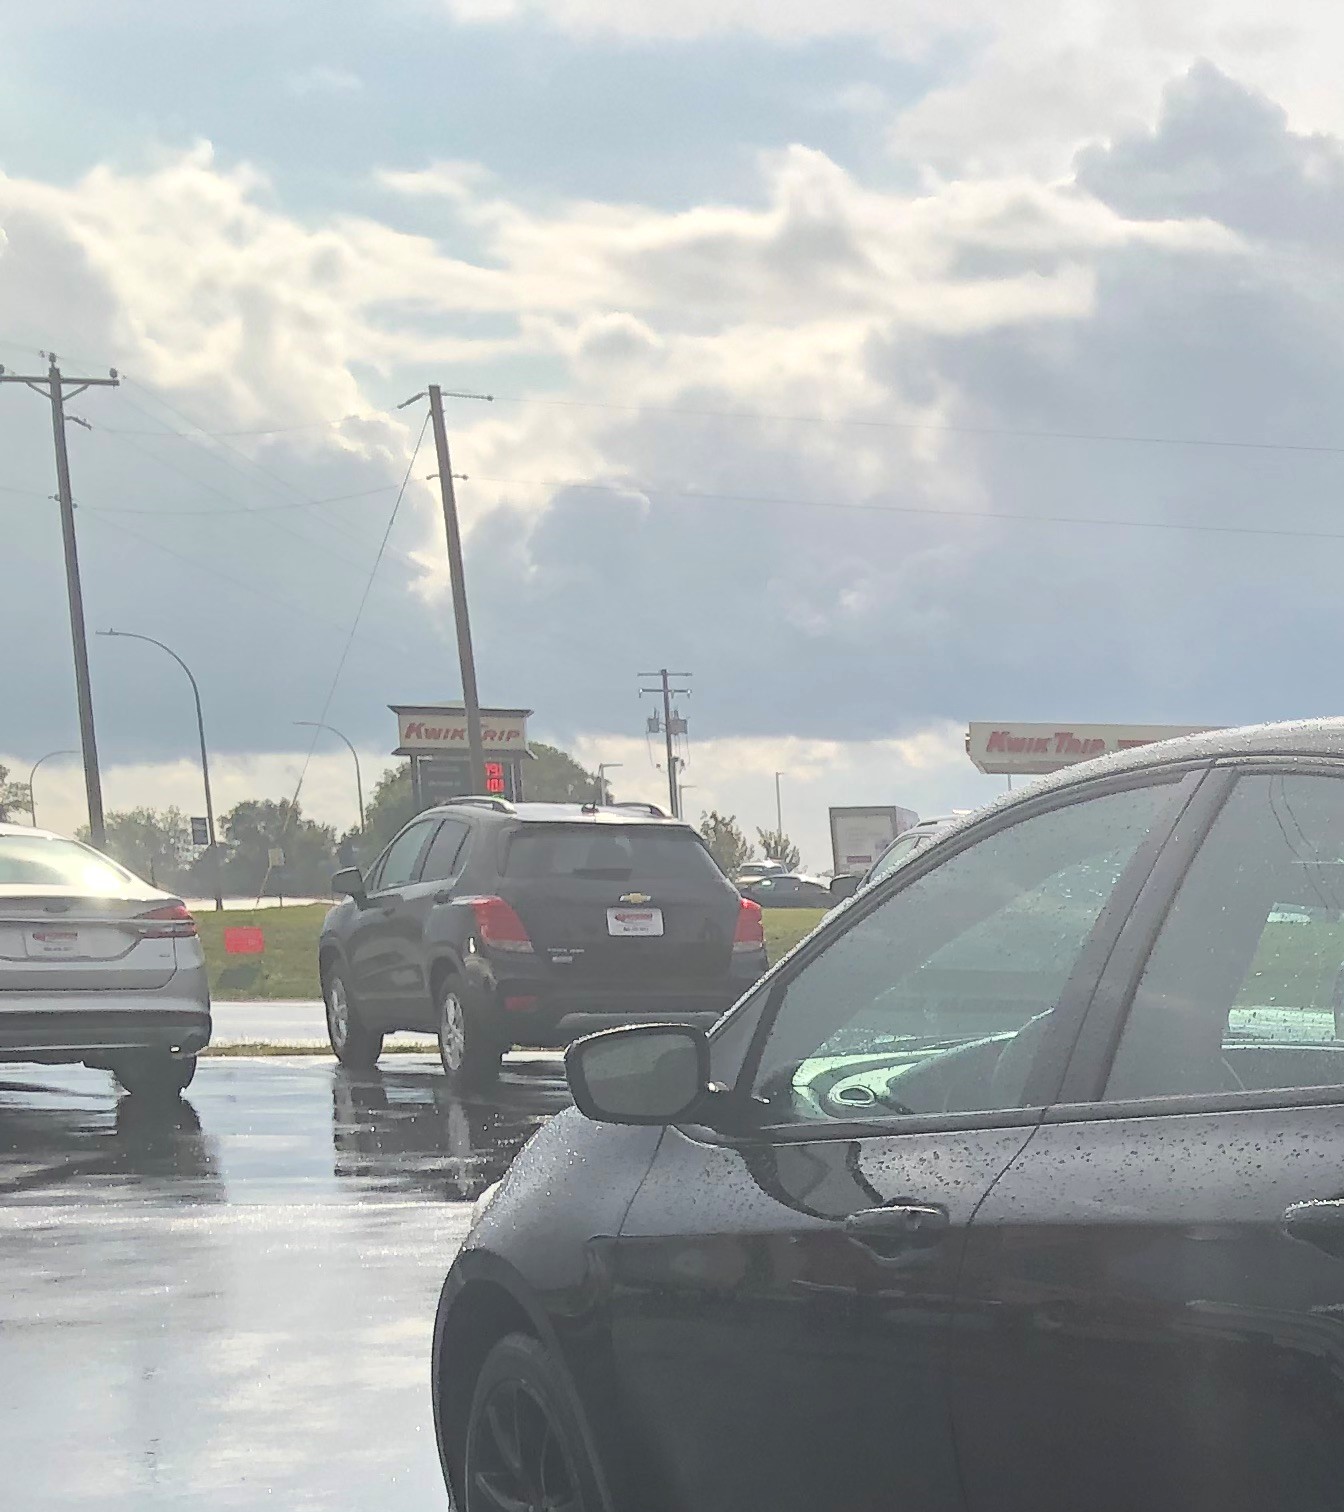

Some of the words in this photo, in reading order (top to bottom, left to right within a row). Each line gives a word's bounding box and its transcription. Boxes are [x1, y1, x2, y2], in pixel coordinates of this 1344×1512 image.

[404, 722, 466, 741] KWIK
[481, 725, 520, 741] RIP
[987, 731, 1050, 753] KWIK
[1054, 732, 1106, 753] TRIP
